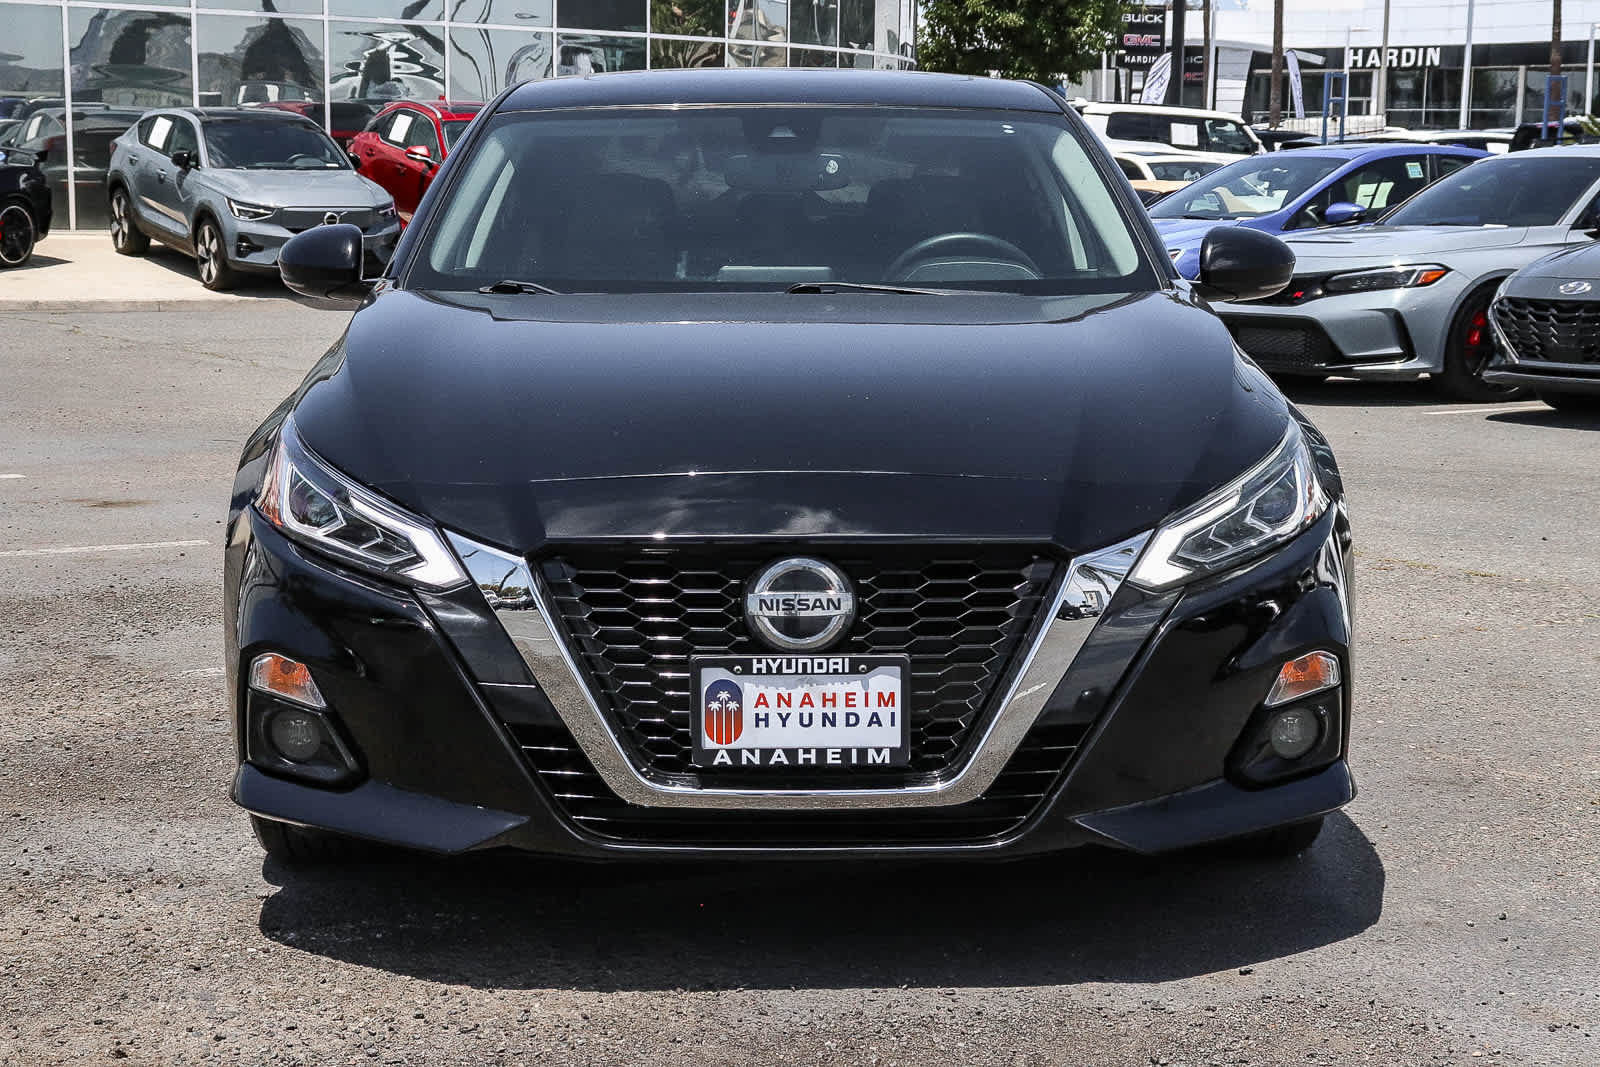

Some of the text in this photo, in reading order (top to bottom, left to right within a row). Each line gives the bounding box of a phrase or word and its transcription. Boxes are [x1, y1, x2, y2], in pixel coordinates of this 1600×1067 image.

[1121, 13, 1164, 24] BUICK
[1123, 34, 1160, 47] GMC
[1348, 47, 1441, 68] HARDIN
[759, 598, 842, 612] NISSAN
[752, 658, 850, 675] HYUNDAI
[753, 691, 896, 709] ANAHEIM
[753, 711, 896, 729] HYUNDAI
[712, 748, 891, 766] ANAHEIM
